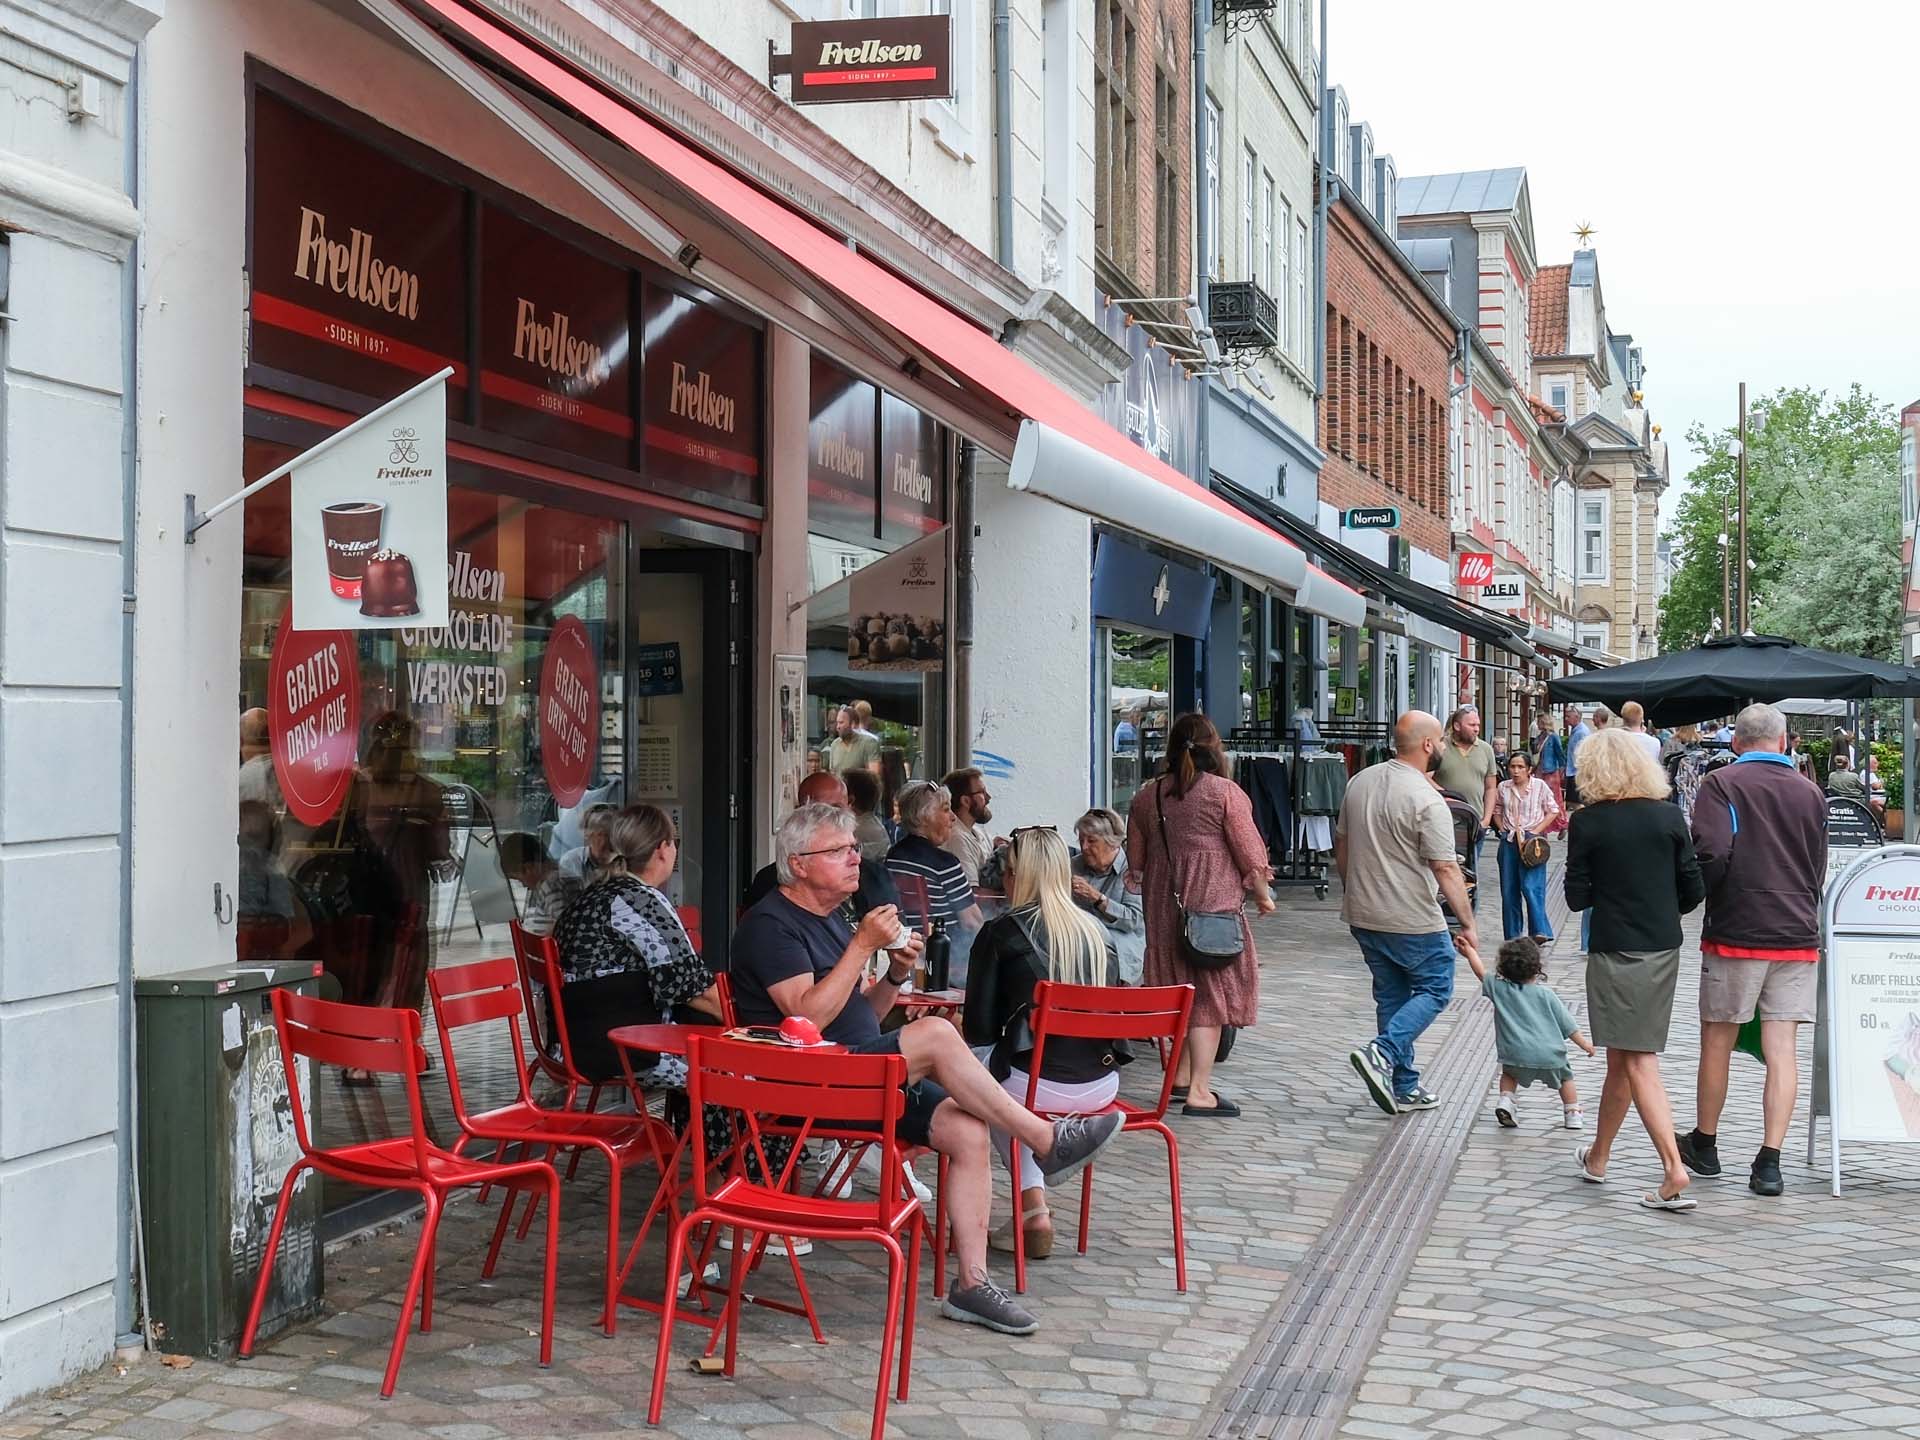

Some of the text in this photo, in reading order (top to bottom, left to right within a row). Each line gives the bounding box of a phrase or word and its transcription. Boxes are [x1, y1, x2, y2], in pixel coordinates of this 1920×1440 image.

[818, 40, 922, 65] Frellsen
[294, 206, 420, 321] Frellsen
[330, 323, 384, 355] SIDEN 1897
[513, 297, 601, 389] Frellsen
[670, 361, 735, 433] Frellsen
[817, 422, 865, 481] Frellsen
[376, 467, 433, 479] Frellsen
[893, 452, 932, 505] Frellsen
[1353, 511, 1391, 525] Normal
[327, 538, 379, 551] Frellsen
[1461, 557, 1491, 584] illy
[1484, 583, 1519, 596] MEN
[286, 642, 340, 714] GRATIS
[407, 662, 507, 705] VÆRKSTED
[555, 657, 589, 724] GRATIS
[286, 714, 318, 766] DRYS
[326, 693, 347, 737] GUF
[547, 695, 568, 743] DRYS
[572, 726, 587, 762] GUF
[1829, 807, 1854, 815] Gratis
[1865, 885, 1920, 901] Frell
[1851, 974, 1886, 985] KÆMPE
[1860, 1013, 1877, 1029] 60
